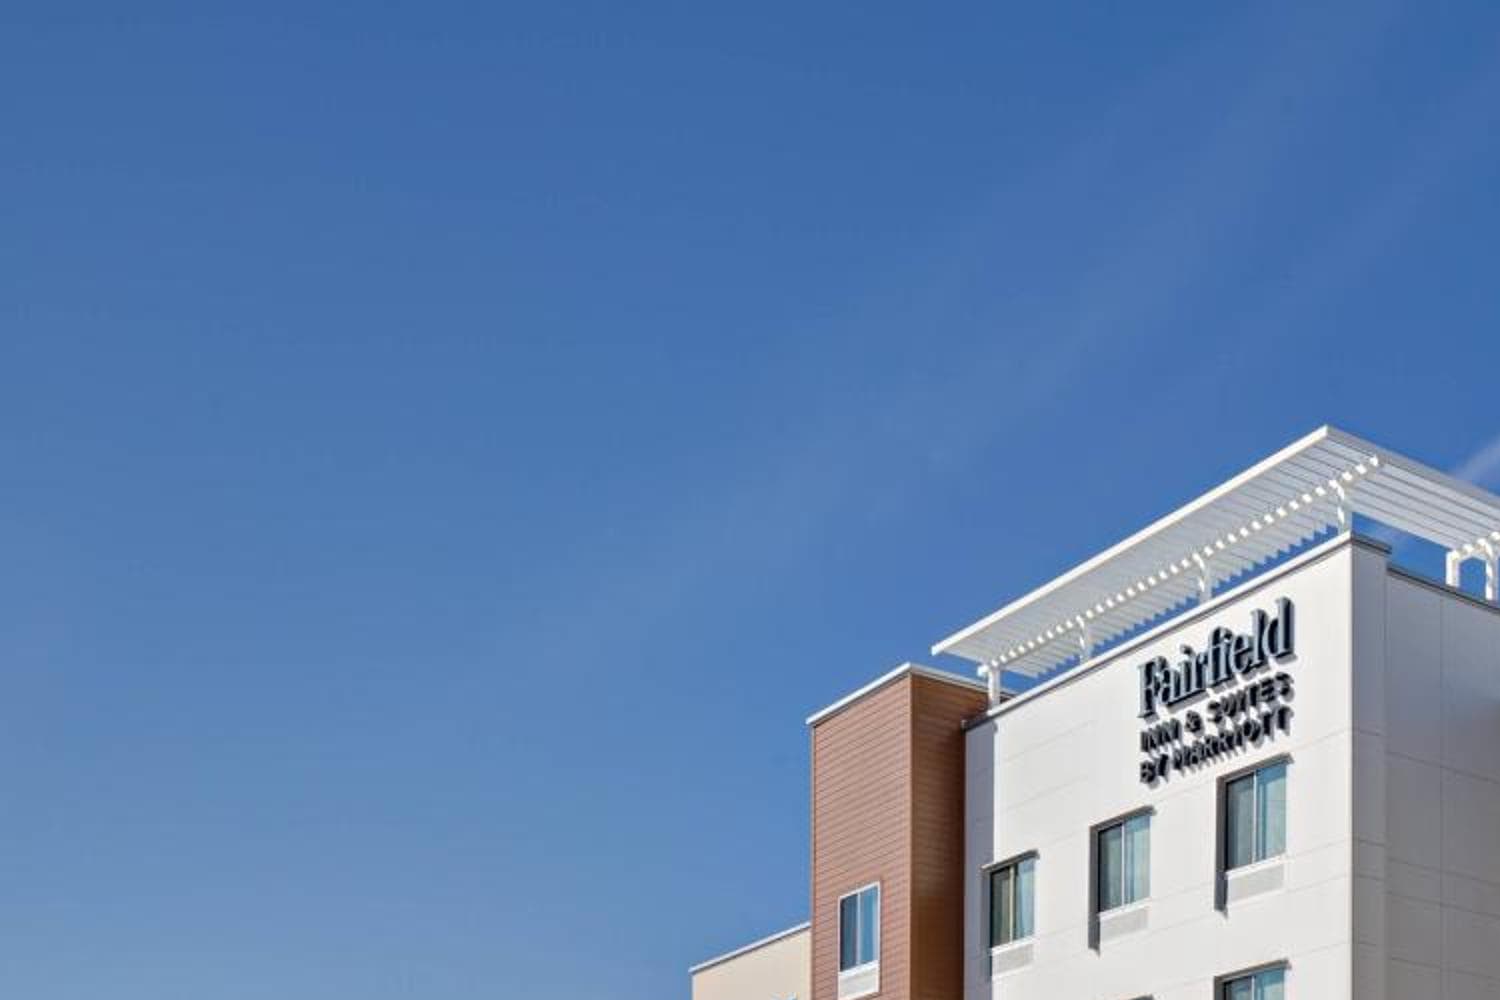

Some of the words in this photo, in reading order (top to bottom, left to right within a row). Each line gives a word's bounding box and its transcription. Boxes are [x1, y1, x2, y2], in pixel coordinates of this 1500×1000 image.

[1138, 597, 1296, 718] Fairfield
[1140, 719, 1180, 752] INN
[1185, 710, 1202, 733] &
[1207, 672, 1294, 724] SUITES
[1140, 754, 1169, 784] BY
[1173, 705, 1293, 771] MARRIOTT
